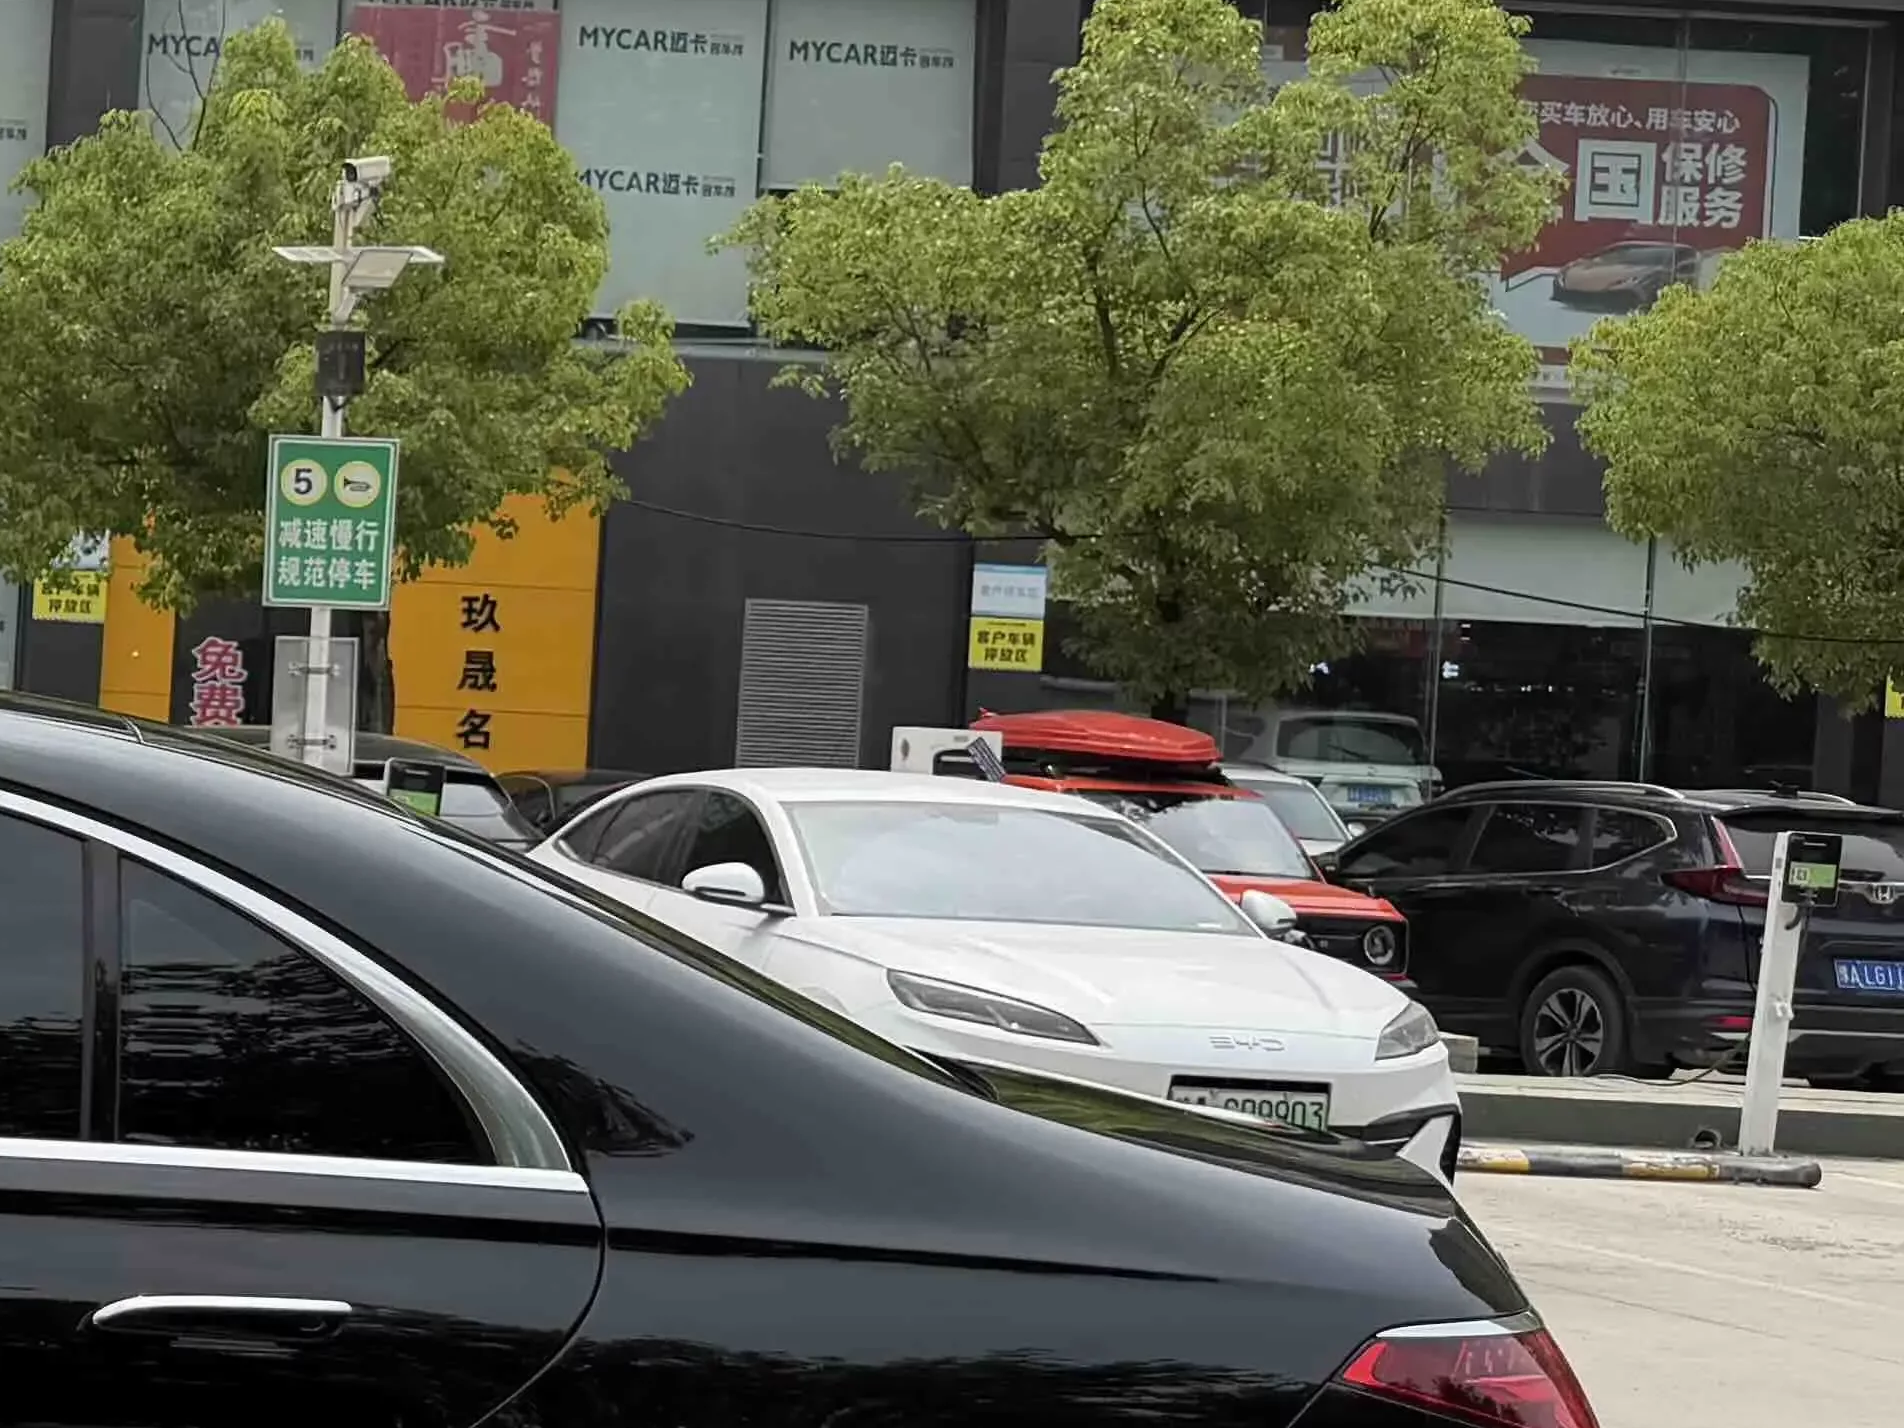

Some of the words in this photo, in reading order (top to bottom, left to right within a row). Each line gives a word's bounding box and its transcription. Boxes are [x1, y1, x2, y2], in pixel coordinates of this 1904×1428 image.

[1660, 140, 1748, 185] 保修
[1658, 184, 1745, 230] 服务
[294, 467, 314, 496] 5
[278, 518, 380, 552] 减速慢行
[276, 555, 376, 590] 规范停车
[189, 635, 249, 728] 免费
[1209, 1036, 1286, 1052] BYD
